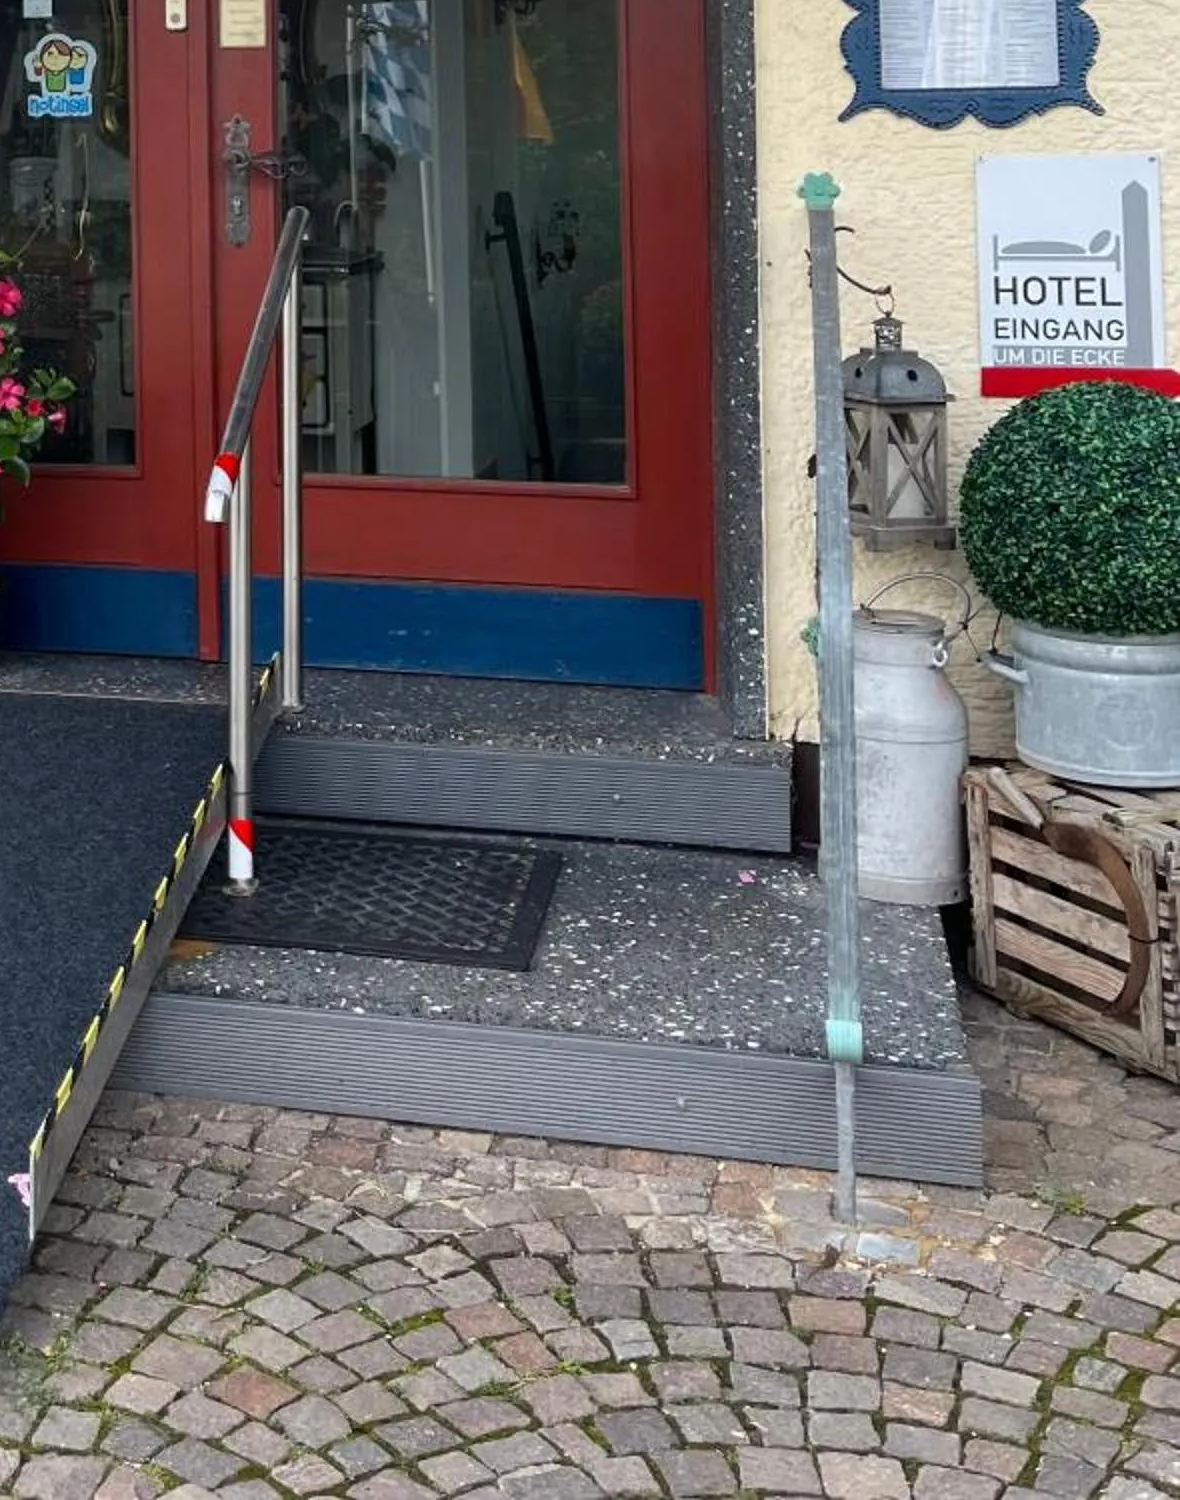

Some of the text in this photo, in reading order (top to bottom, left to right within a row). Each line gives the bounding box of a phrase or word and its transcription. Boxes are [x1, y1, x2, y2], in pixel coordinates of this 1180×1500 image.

[993, 275, 1124, 307] HOTEL
[994, 317, 1125, 341] EINGANG
[994, 348, 1125, 366] UM DIE ECKE
